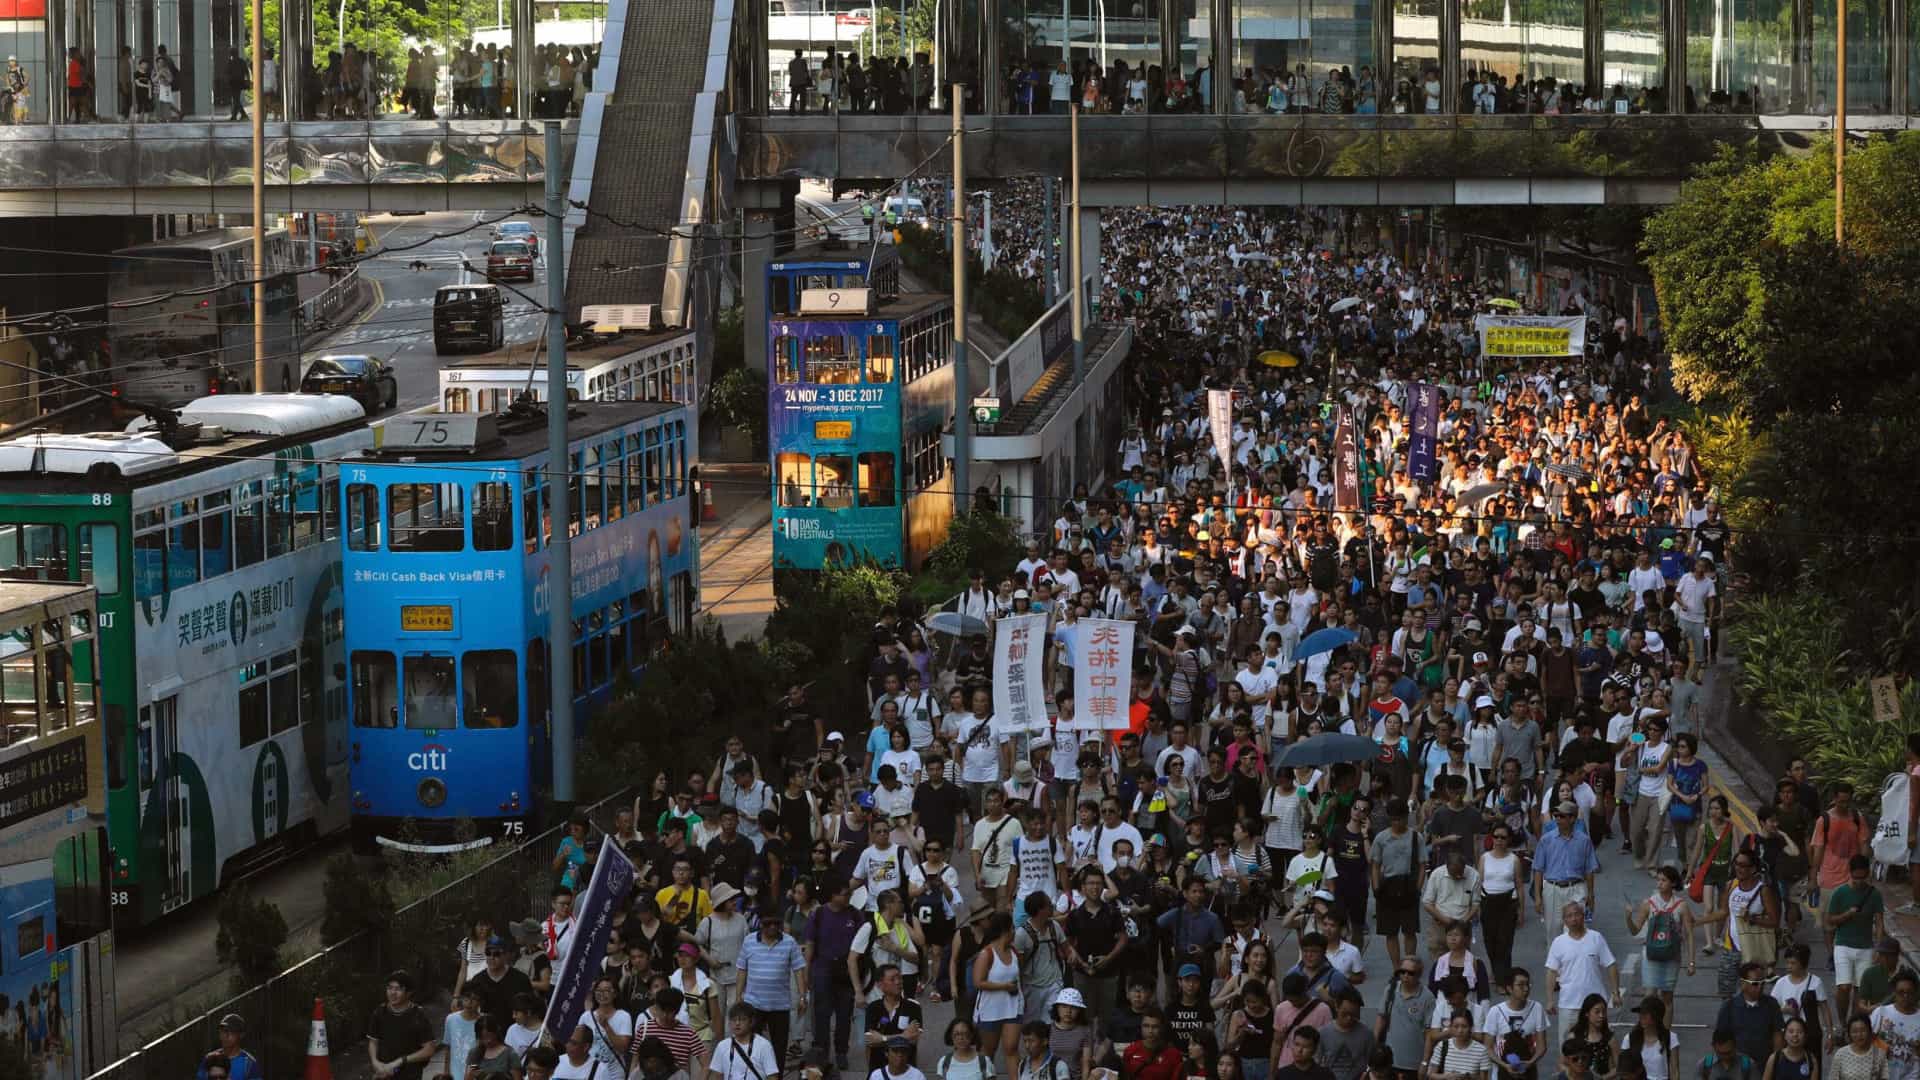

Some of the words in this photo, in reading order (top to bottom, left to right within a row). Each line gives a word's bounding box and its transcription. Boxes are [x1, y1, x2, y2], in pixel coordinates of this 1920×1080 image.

[829, 293, 840, 308] 9
[876, 324, 884, 334] 9
[449, 372, 462, 381] 161
[784, 390, 796, 402] 24
[798, 390, 817, 402] NOV
[829, 390, 835, 402] 3
[838, 390, 857, 402] DEC
[860, 389, 883, 402] 2017
[412, 421, 449, 444] 75
[352, 470, 366, 481] 75
[490, 468, 506, 480] 75
[92, 493, 112, 506] 88
[800, 519, 820, 530] DAYS
[800, 530, 834, 539] FESTIVALS
[392, 571, 417, 582] Cash
[419, 571, 445, 582] Back
[408, 748, 447, 771] citi
[503, 822, 523, 835] 75
[919, 905, 932, 924] C
[1177, 1011, 1198, 1020] YOU
[1177, 1031, 1193, 1041] YO
